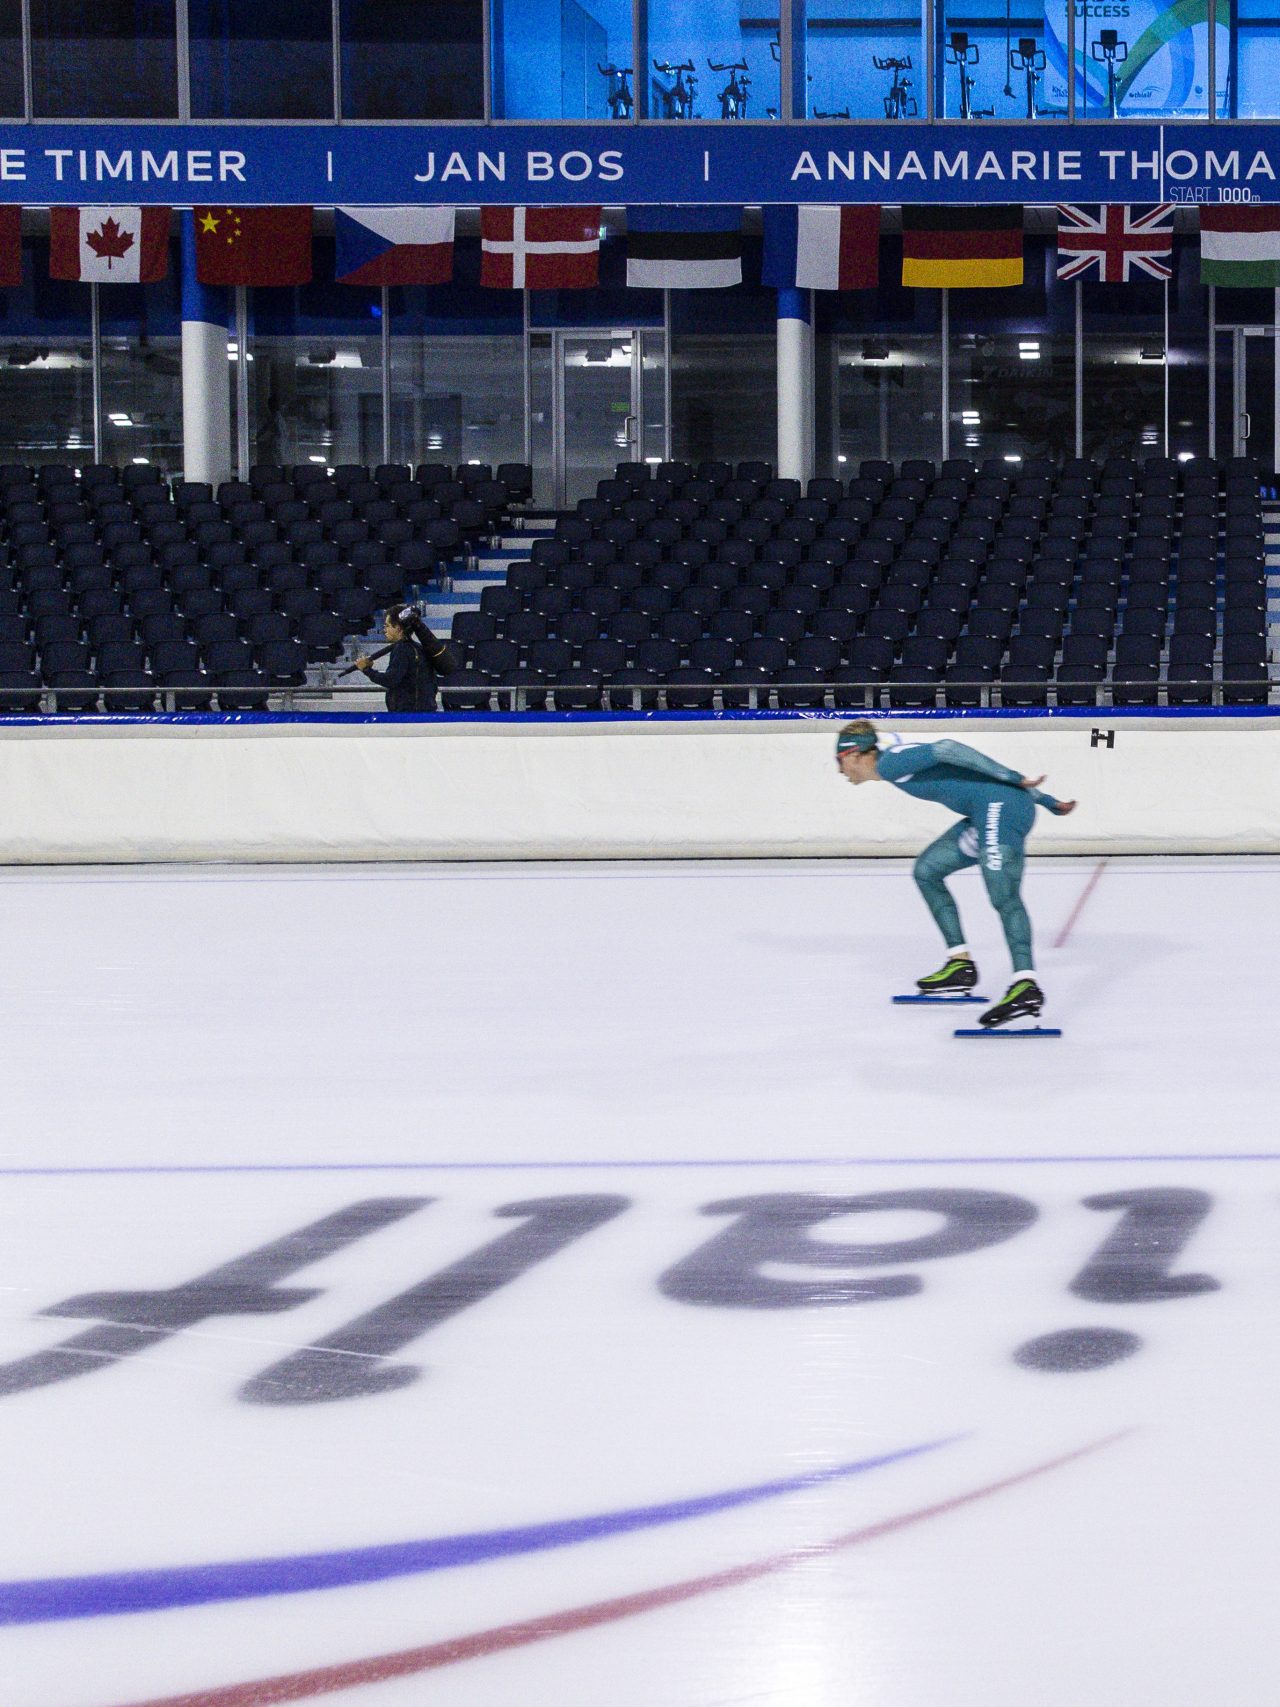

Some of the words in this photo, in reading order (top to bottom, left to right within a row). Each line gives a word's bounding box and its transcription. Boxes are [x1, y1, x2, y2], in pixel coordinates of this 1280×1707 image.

[0, 149, 27, 181] E
[44, 149, 247, 182] TIMMER
[414, 151, 505, 181] JAN
[527, 150, 624, 181] BOS
[790, 150, 1082, 181] ANNAMARIE
[1169, 187, 1212, 203] START
[1217, 187, 1261, 203] 1000m
